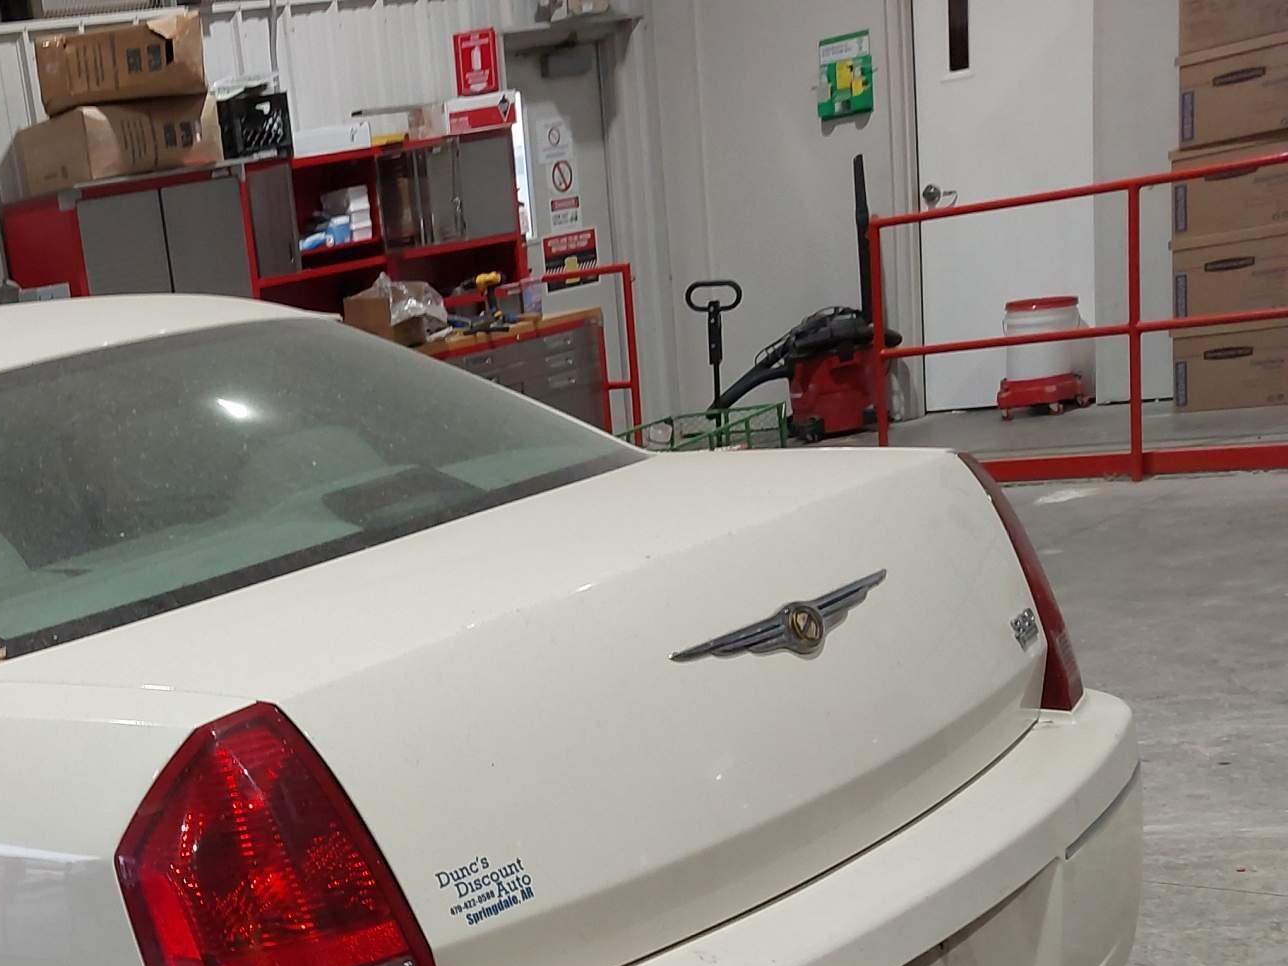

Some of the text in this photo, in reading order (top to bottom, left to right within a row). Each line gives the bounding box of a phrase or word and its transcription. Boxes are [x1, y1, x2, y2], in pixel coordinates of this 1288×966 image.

[435, 856, 489, 888] Dunc's
[455, 858, 524, 898] Discount
[497, 874, 531, 898] Auto
[521, 886, 534, 901] AR
